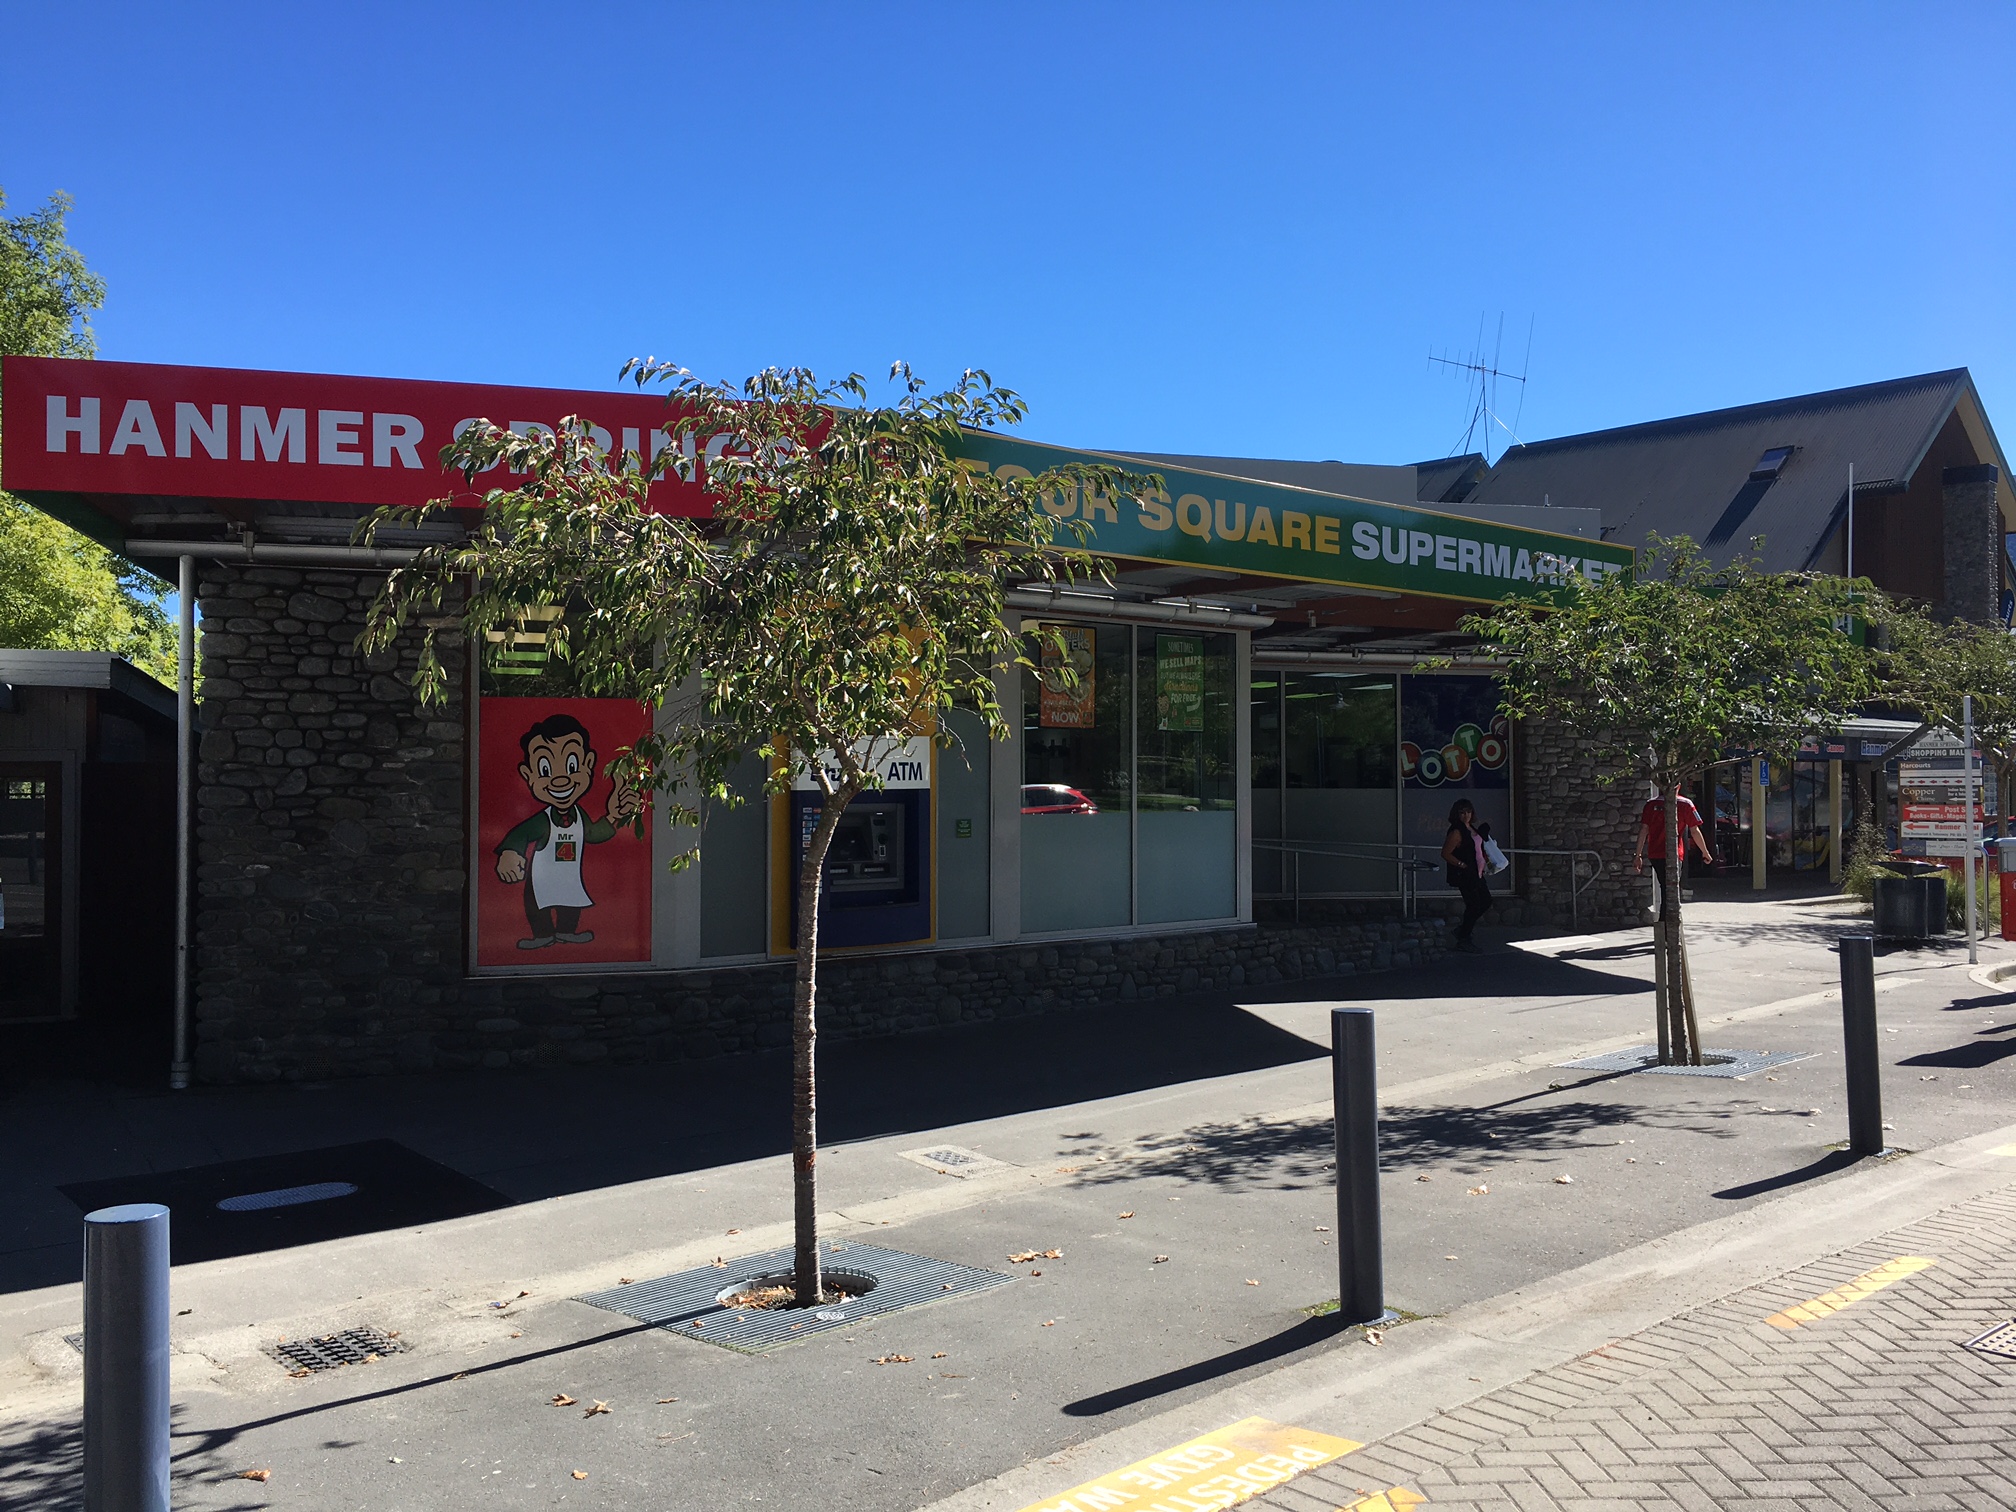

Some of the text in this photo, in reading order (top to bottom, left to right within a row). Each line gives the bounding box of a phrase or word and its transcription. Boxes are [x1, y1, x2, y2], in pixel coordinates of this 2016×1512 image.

[46, 395, 425, 470] HANMER
[1137, 486, 1341, 554] SQUARE
[1044, 638, 1090, 652] OYTERS
[1051, 711, 1079, 723] NOW
[1400, 729, 1502, 780] LOTTO
[1910, 749, 1947, 757] SHOPPING
[1949, 749, 1965, 757] MAL
[887, 761, 922, 781] ATM
[1902, 787, 1936, 796] Copper
[1961, 806, 1979, 814] Sp
[557, 833, 574, 841] Mr
[556, 842, 575, 861] 4
[1118, 1444, 1235, 1490] GIVE
